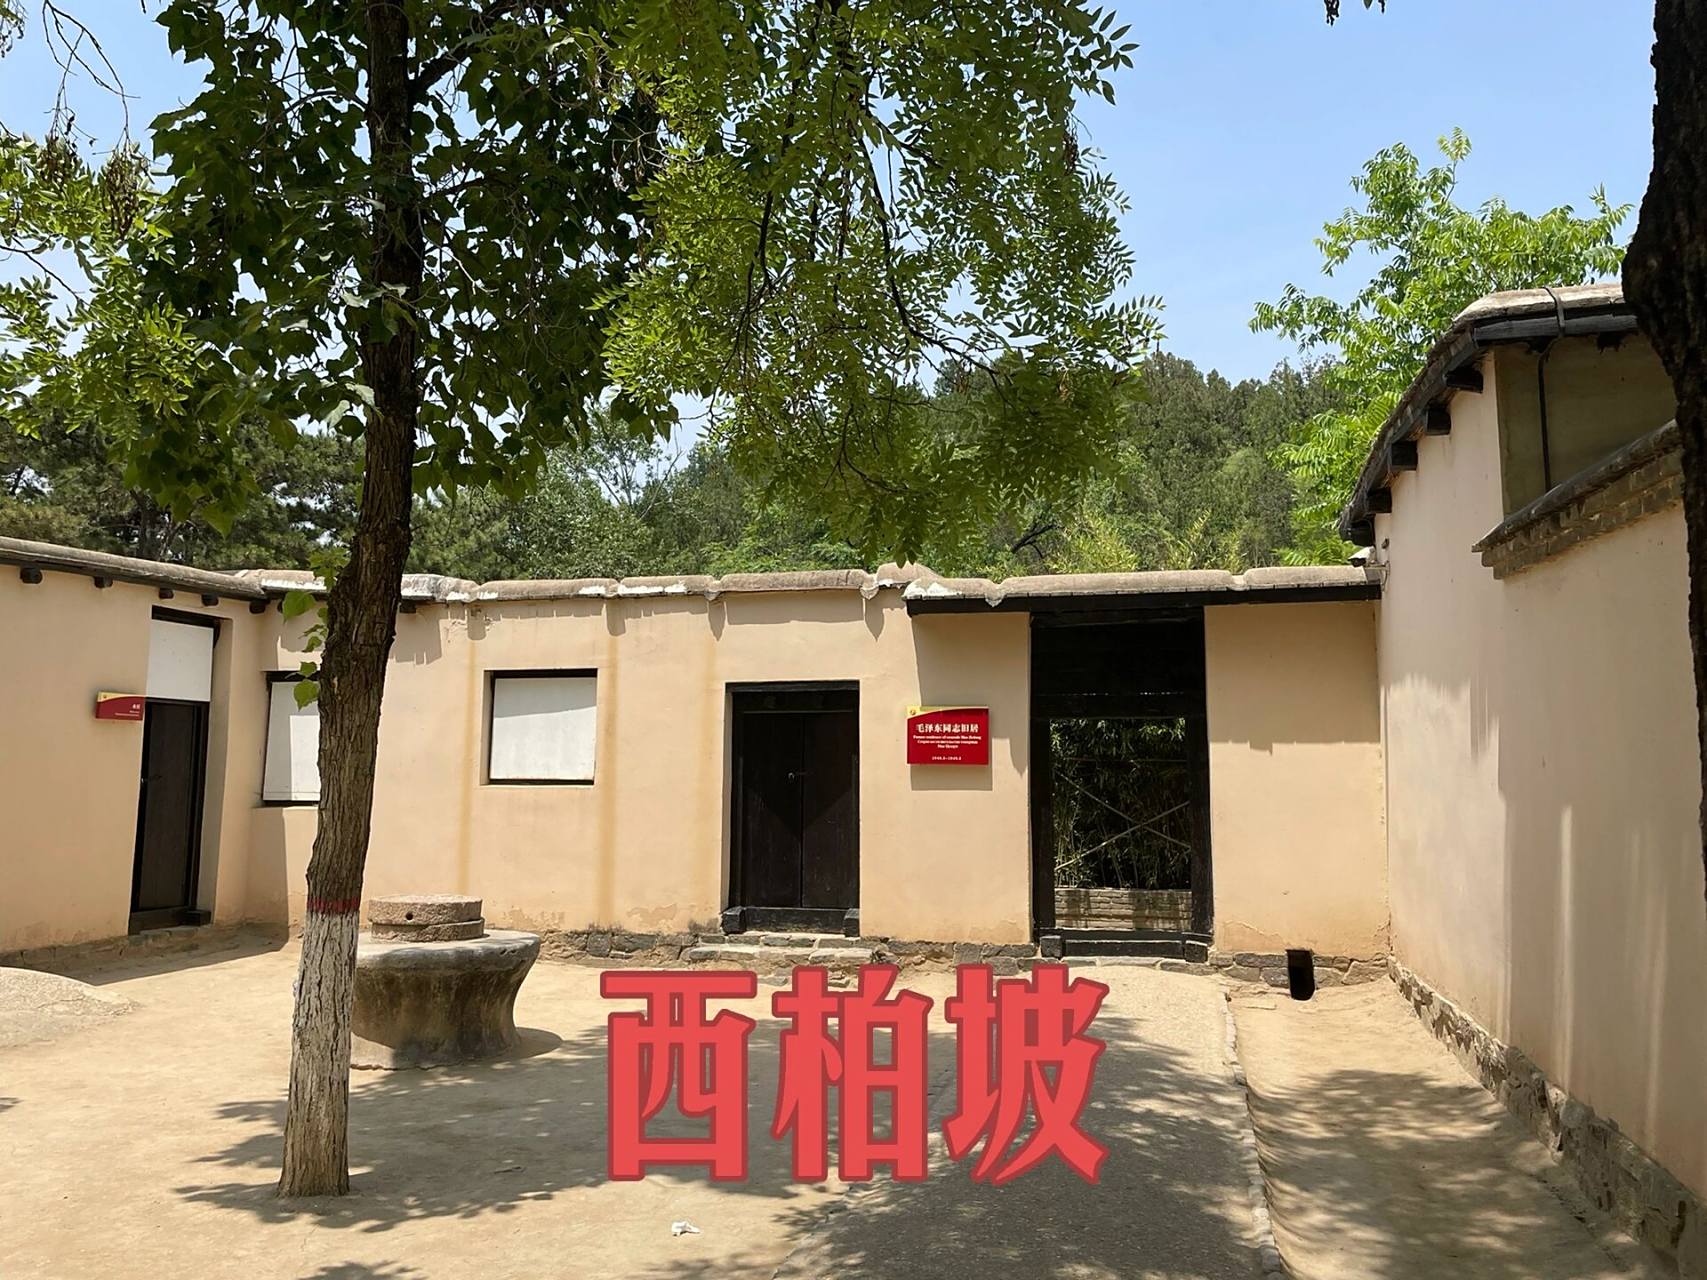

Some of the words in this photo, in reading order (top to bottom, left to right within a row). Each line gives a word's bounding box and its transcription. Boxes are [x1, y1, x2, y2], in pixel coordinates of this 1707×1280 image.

[916, 723, 979, 733] 毛泽东同志旧居
